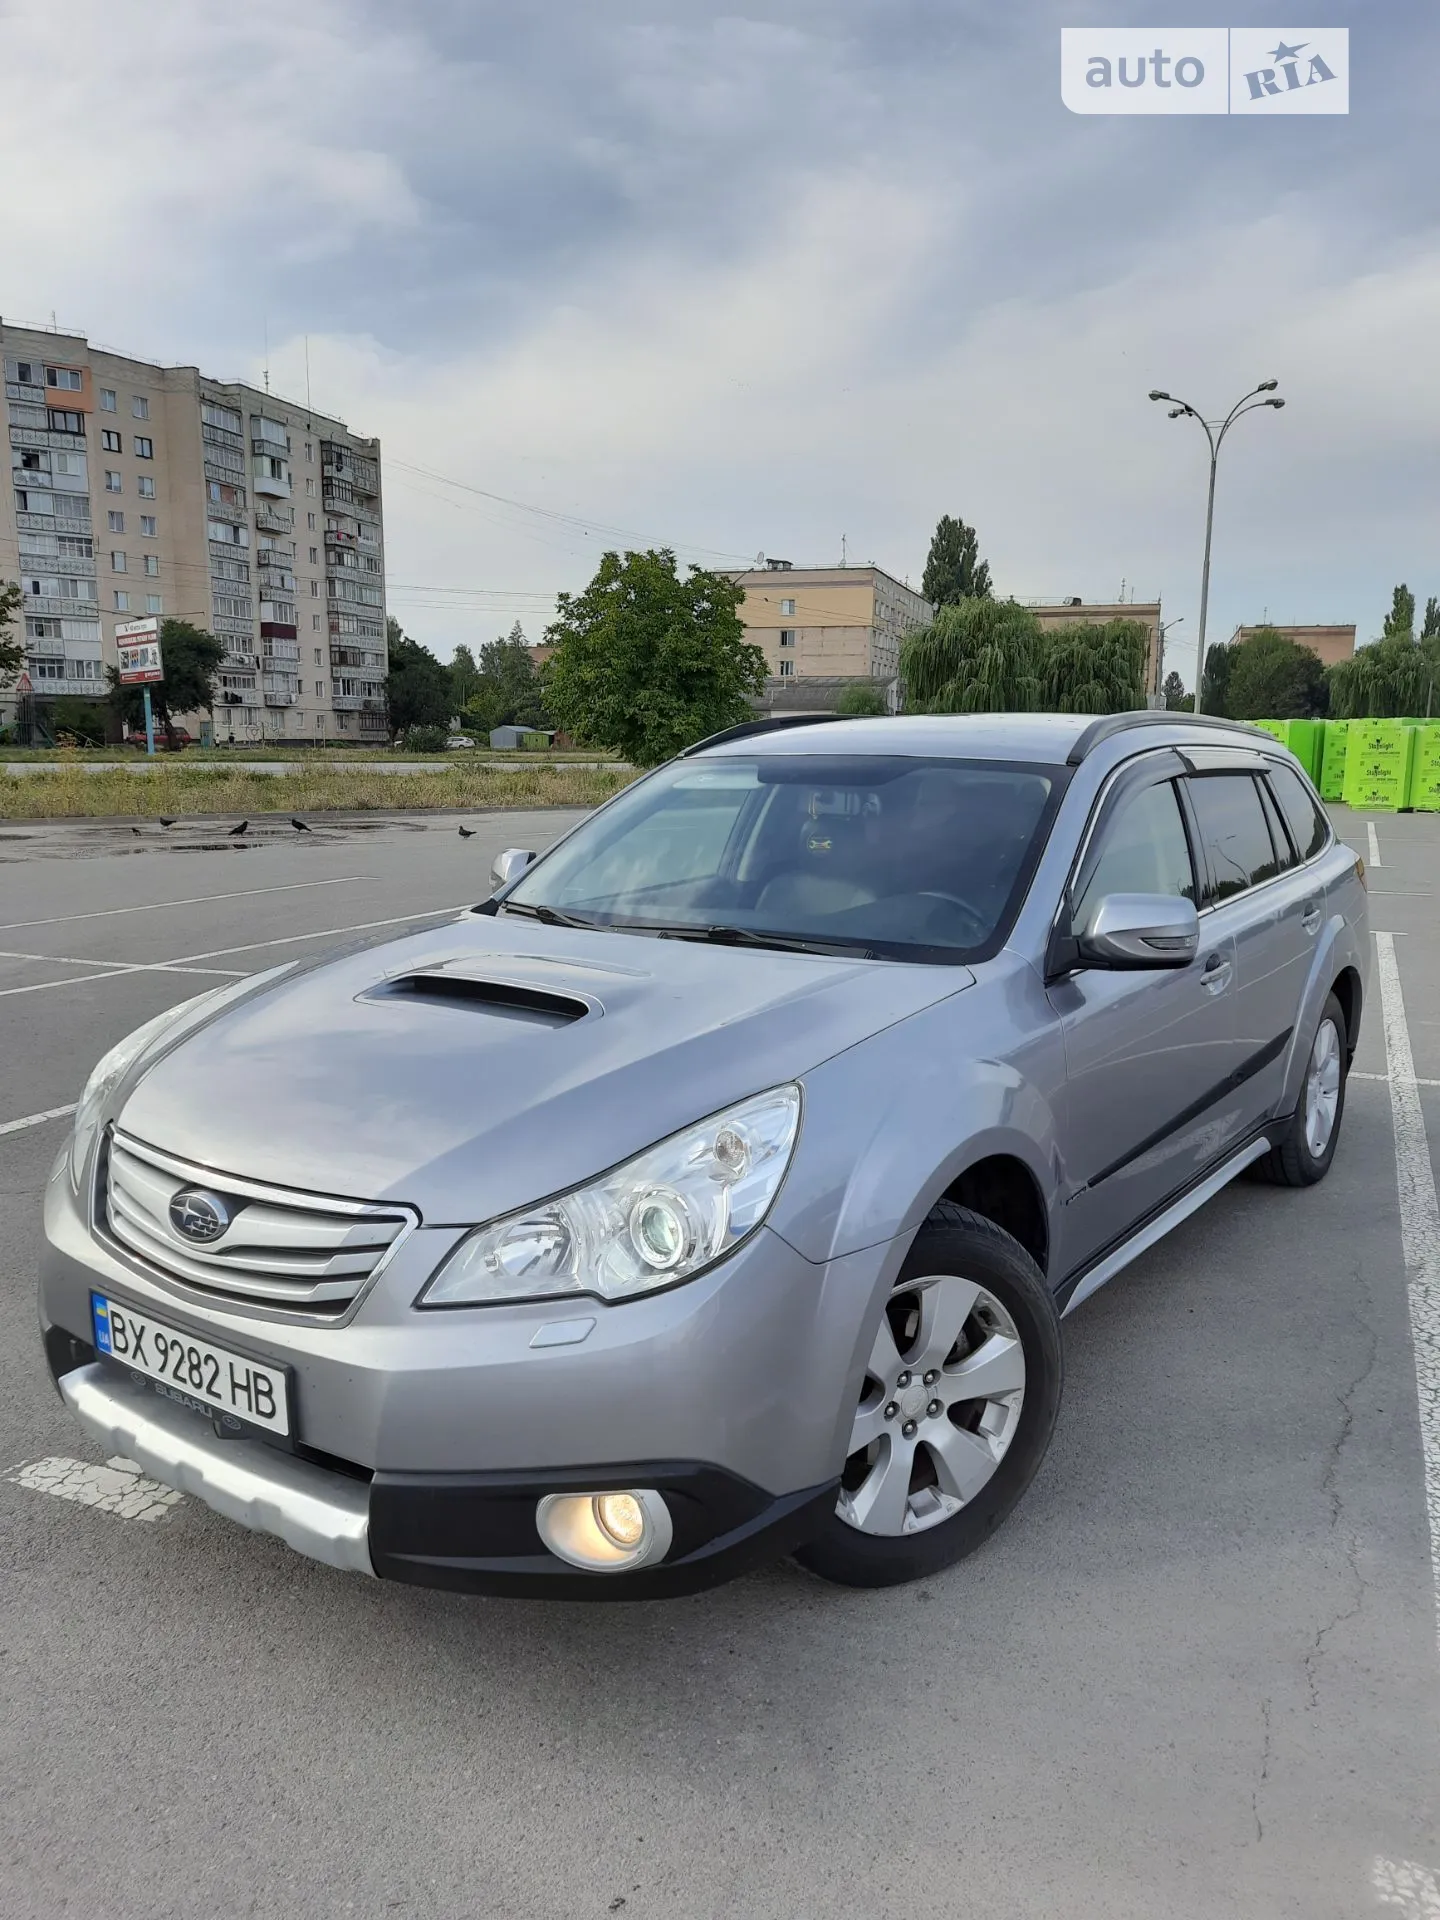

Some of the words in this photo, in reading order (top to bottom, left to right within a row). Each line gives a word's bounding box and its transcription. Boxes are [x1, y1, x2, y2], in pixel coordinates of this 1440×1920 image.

[110, 1310, 149, 1367] BX
[154, 1332, 222, 1400] 9282
[229, 1362, 276, 1419] HB
[155, 1383, 213, 1418] SUBARU
